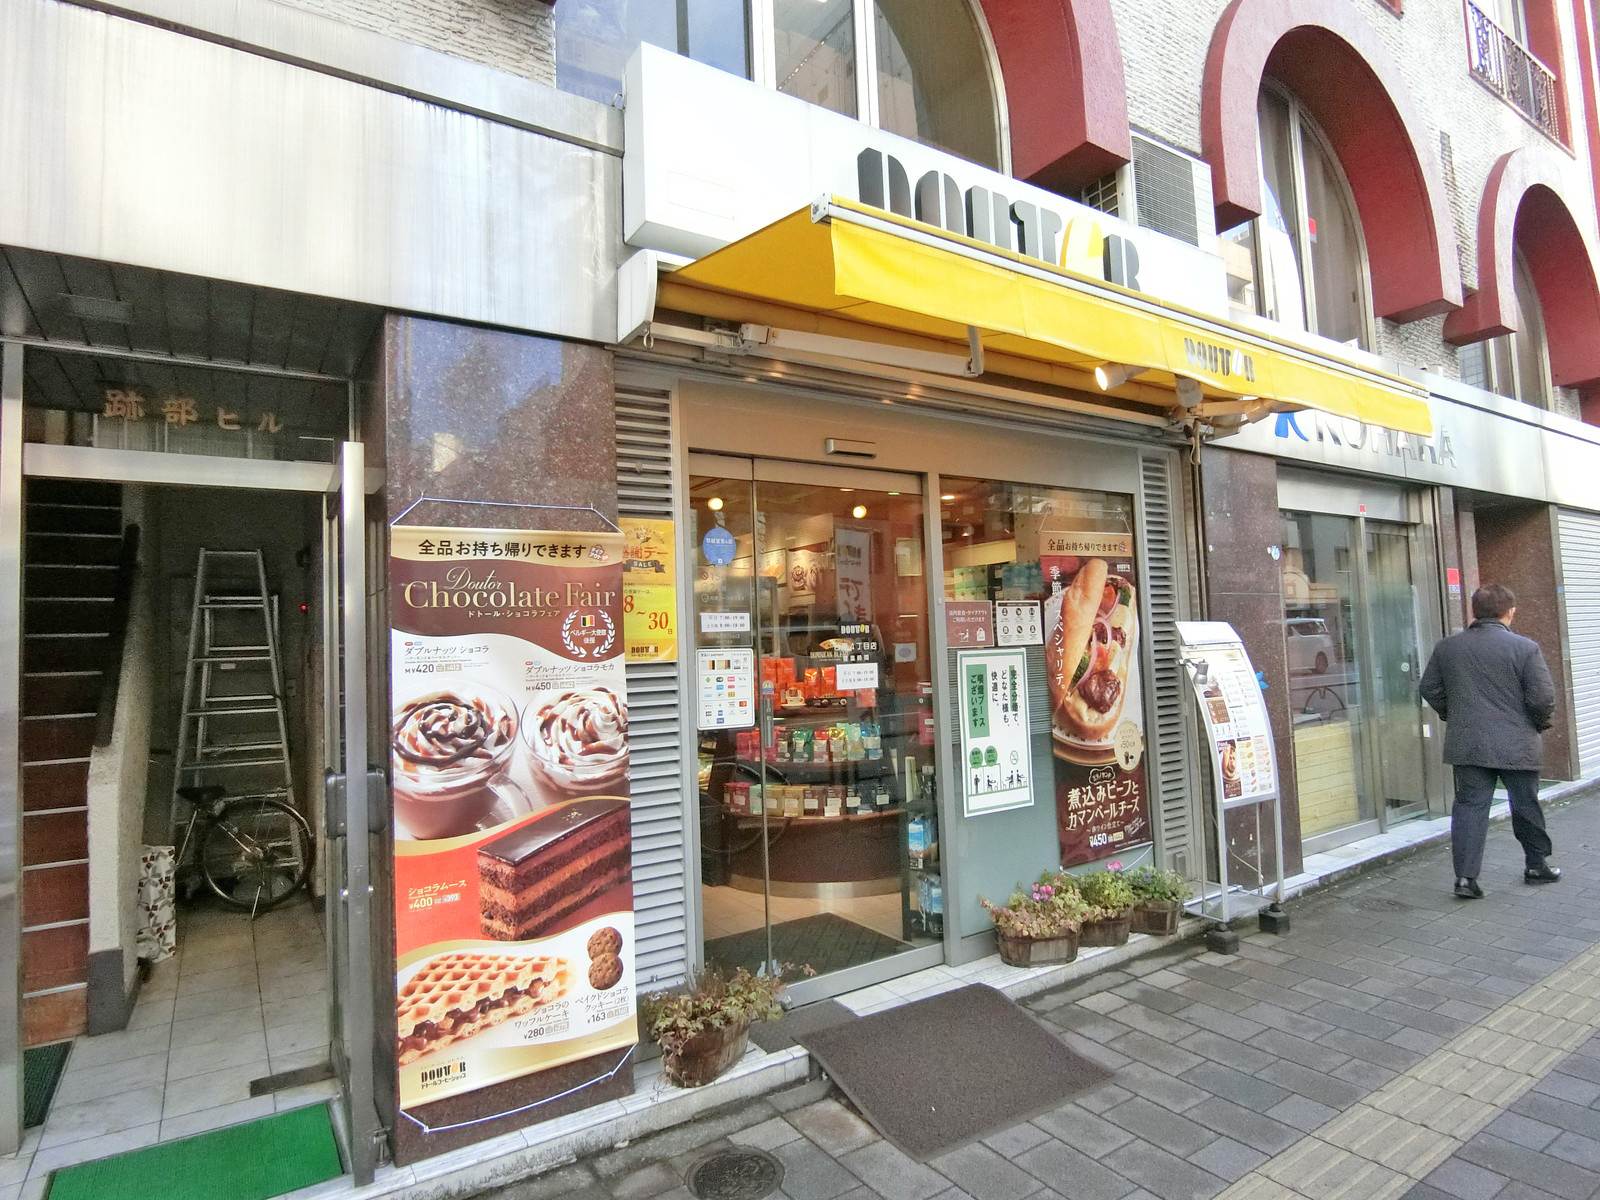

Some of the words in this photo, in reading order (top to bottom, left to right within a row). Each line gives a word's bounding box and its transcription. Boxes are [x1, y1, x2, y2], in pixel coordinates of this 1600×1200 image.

[857, 147, 1141, 292] DOUTOR
[1184, 337, 1255, 383] DOUTOR
[418, 539, 587, 560] 全品お持ち帰りできます
[1048, 539, 1118, 552] 全品お持ち帰りできます
[633, 561, 653, 569] SALE
[446, 566, 503, 591] Doutor
[404, 580, 559, 609] Chocolate
[563, 582, 616, 608] Fair
[467, 609, 561, 619] ドトール・ショコラフェア
[840, 624, 870, 634] DOUTOR
[1050, 565, 1066, 690] 季節のスペシャリテ。
[405, 646, 457, 657] ダブルナッツ
[459, 645, 490, 654] ショコラ
[412, 664, 435, 674] ¥420
[525, 665, 572, 676] ダブルナッツ
[573, 663, 615, 672] ショコラモカ
[531, 682, 552, 691] ¥450
[970, 674, 978, 728] ございます
[977, 674, 986, 727] 喫煙ブース
[1001, 670, 1010, 727] どなた様も、
[1010, 669, 1020, 726] 完全分煙で、
[1067, 780, 1139, 811] 煮込みビーフと
[1067, 796, 1140, 830] カマンベールチーズ
[1089, 832, 1107, 848] ¥450
[408, 880, 467, 897] ショコラムース
[409, 897, 433, 910] ¥400
[575, 986, 629, 1004] ベイクドショコラ
[533, 1000, 570, 1016] ショコラの
[514, 1010, 570, 1029] ワッフルケーキ
[587, 1012, 606, 1024] ¥163
[523, 1027, 545, 1040] ¥280
[421, 1061, 466, 1083] DOUTOR
